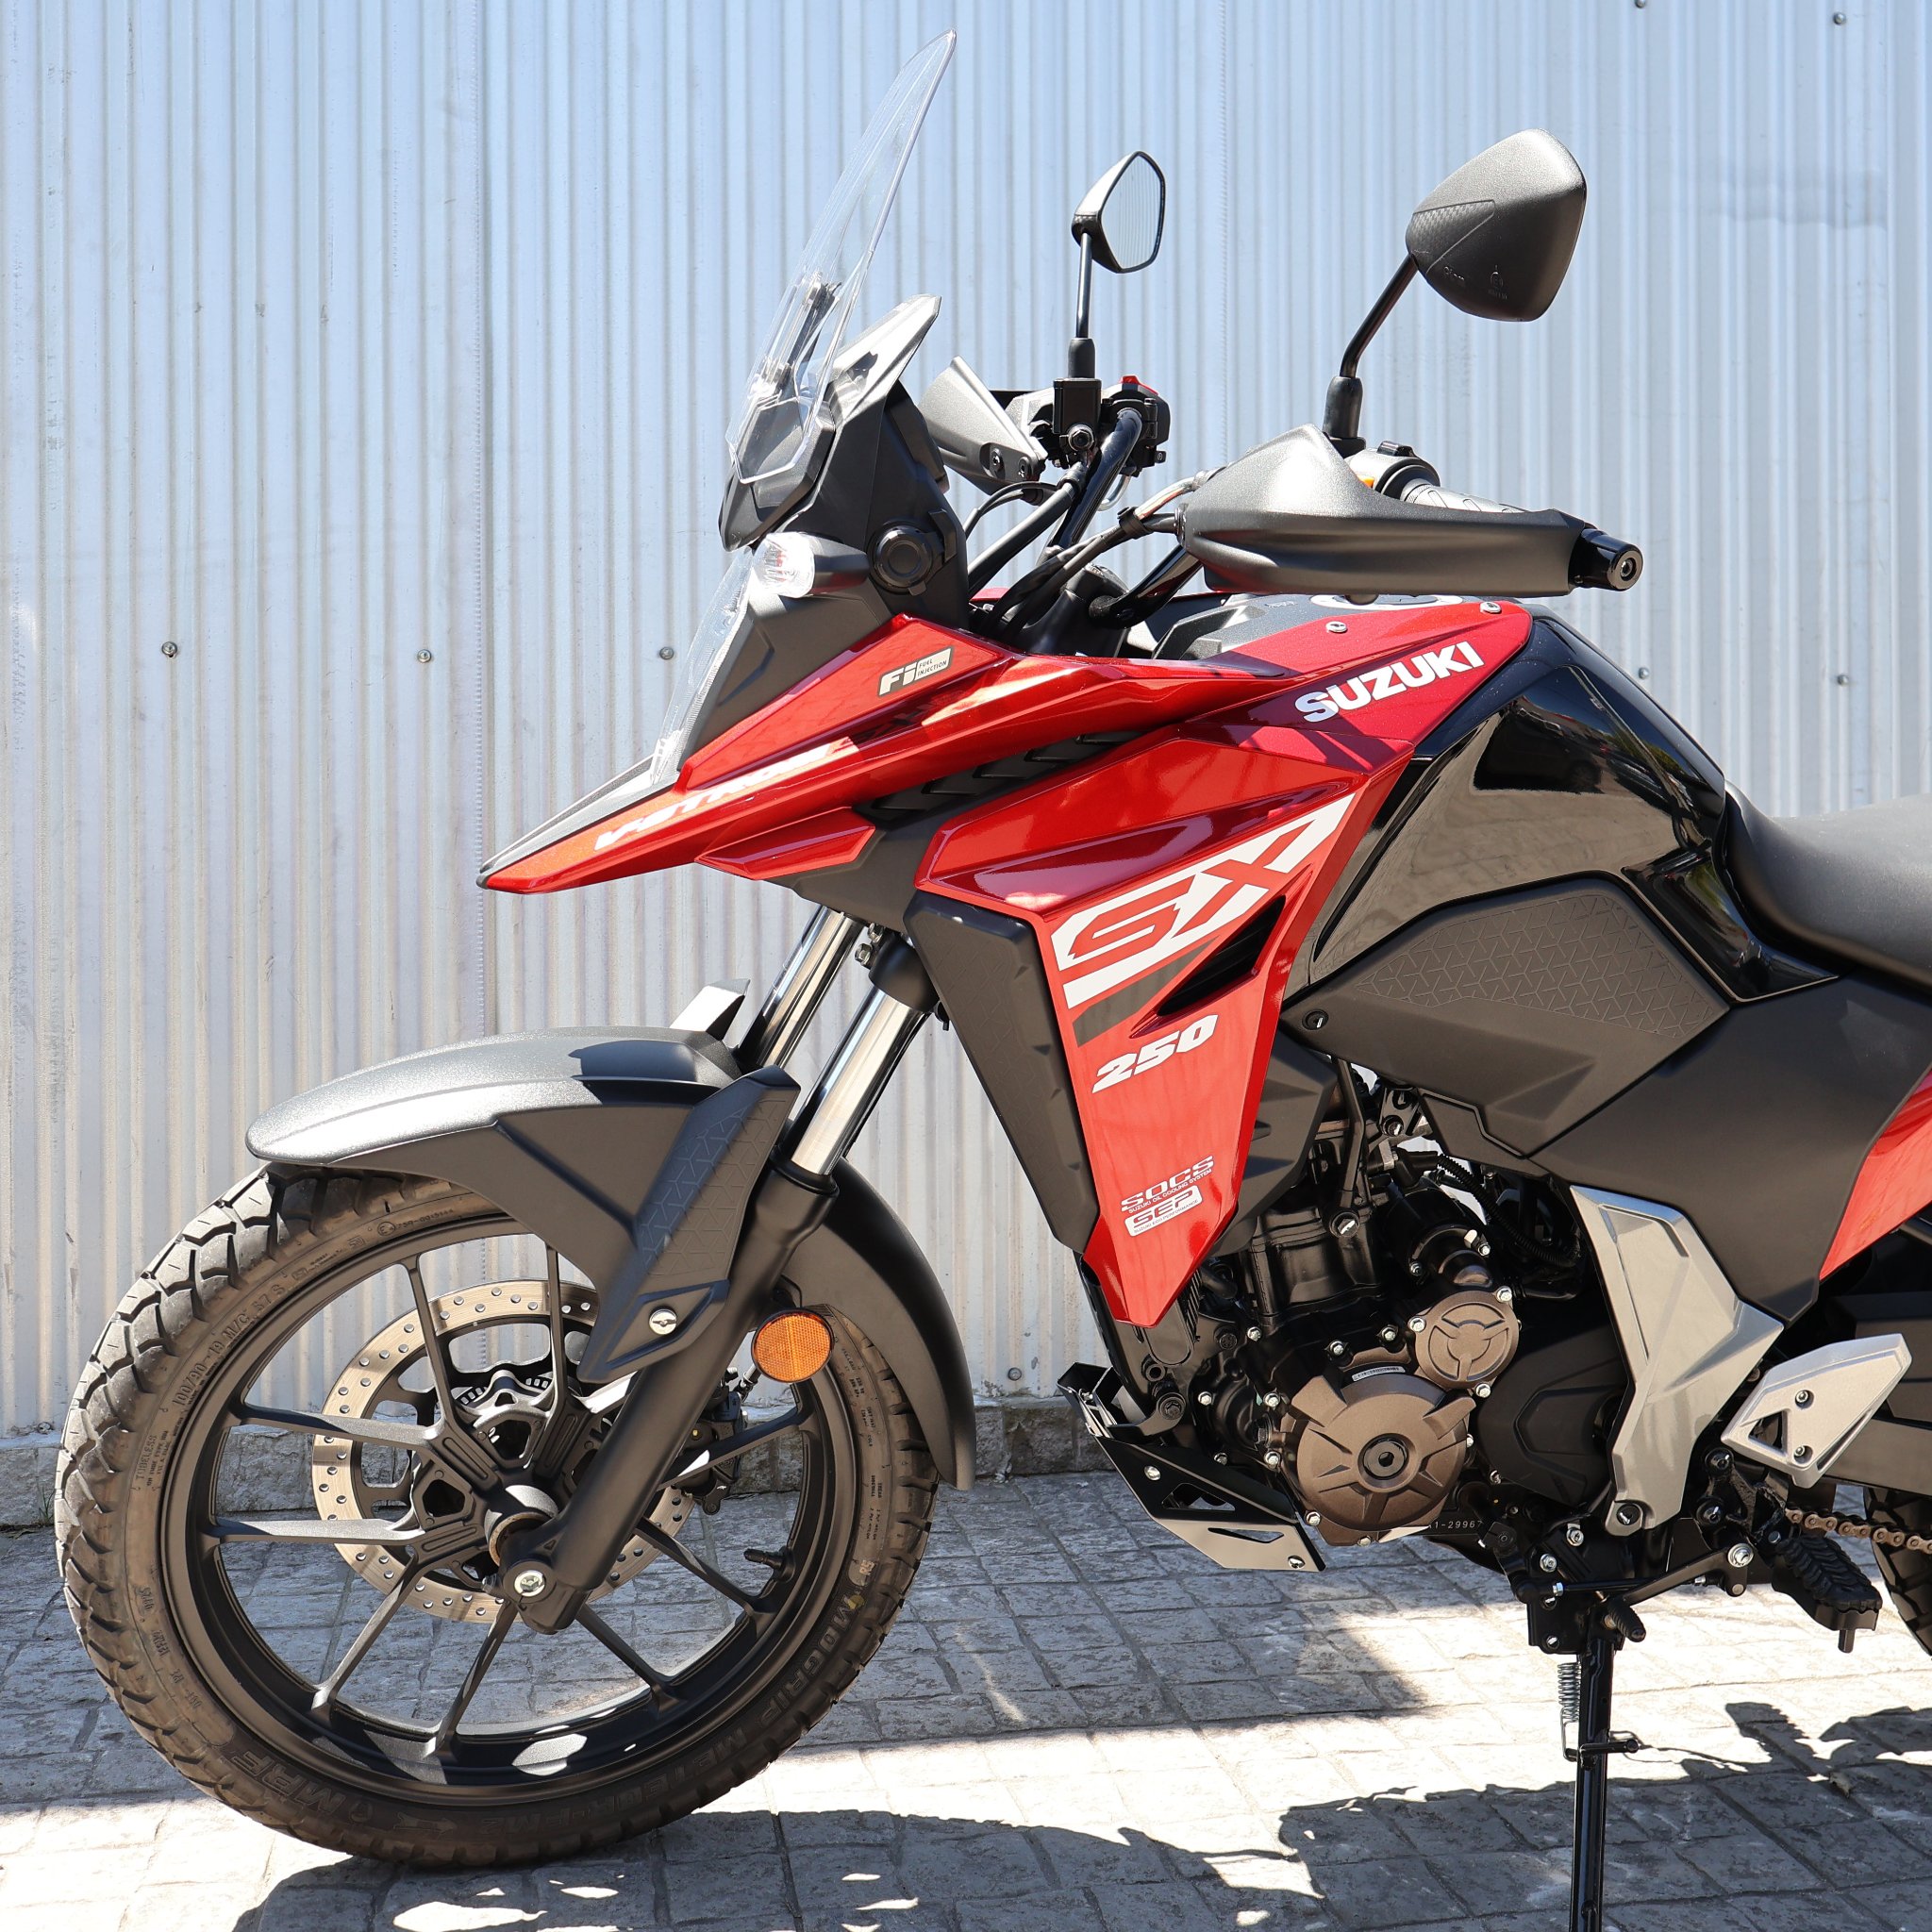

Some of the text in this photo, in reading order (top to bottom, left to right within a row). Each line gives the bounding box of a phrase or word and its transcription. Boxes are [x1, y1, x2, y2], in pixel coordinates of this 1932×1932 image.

[879, 661, 918, 696] Fi
[918, 660, 947, 676] INJECTION
[919, 659, 933, 668] FUEL
[1295, 641, 1485, 723] SUZUKI
[1091, 1014, 1219, 1092] 250
[1121, 1156, 1214, 1212] SOCS
[1128, 1200, 1152, 1214] SUZUKI
[1162, 1181, 1189, 1197] COOLING
[1189, 1168, 1212, 1184] SYSTEM
[1133, 1190, 1193, 1228] SEP
[1134, 1199, 1199, 1233] SUZUKI ECO PERFORMANCE
[222, 1312, 250, 1340] M/C
[136, 1435, 158, 1480] TUBELESS
[230, 1751, 346, 1816] MRF
